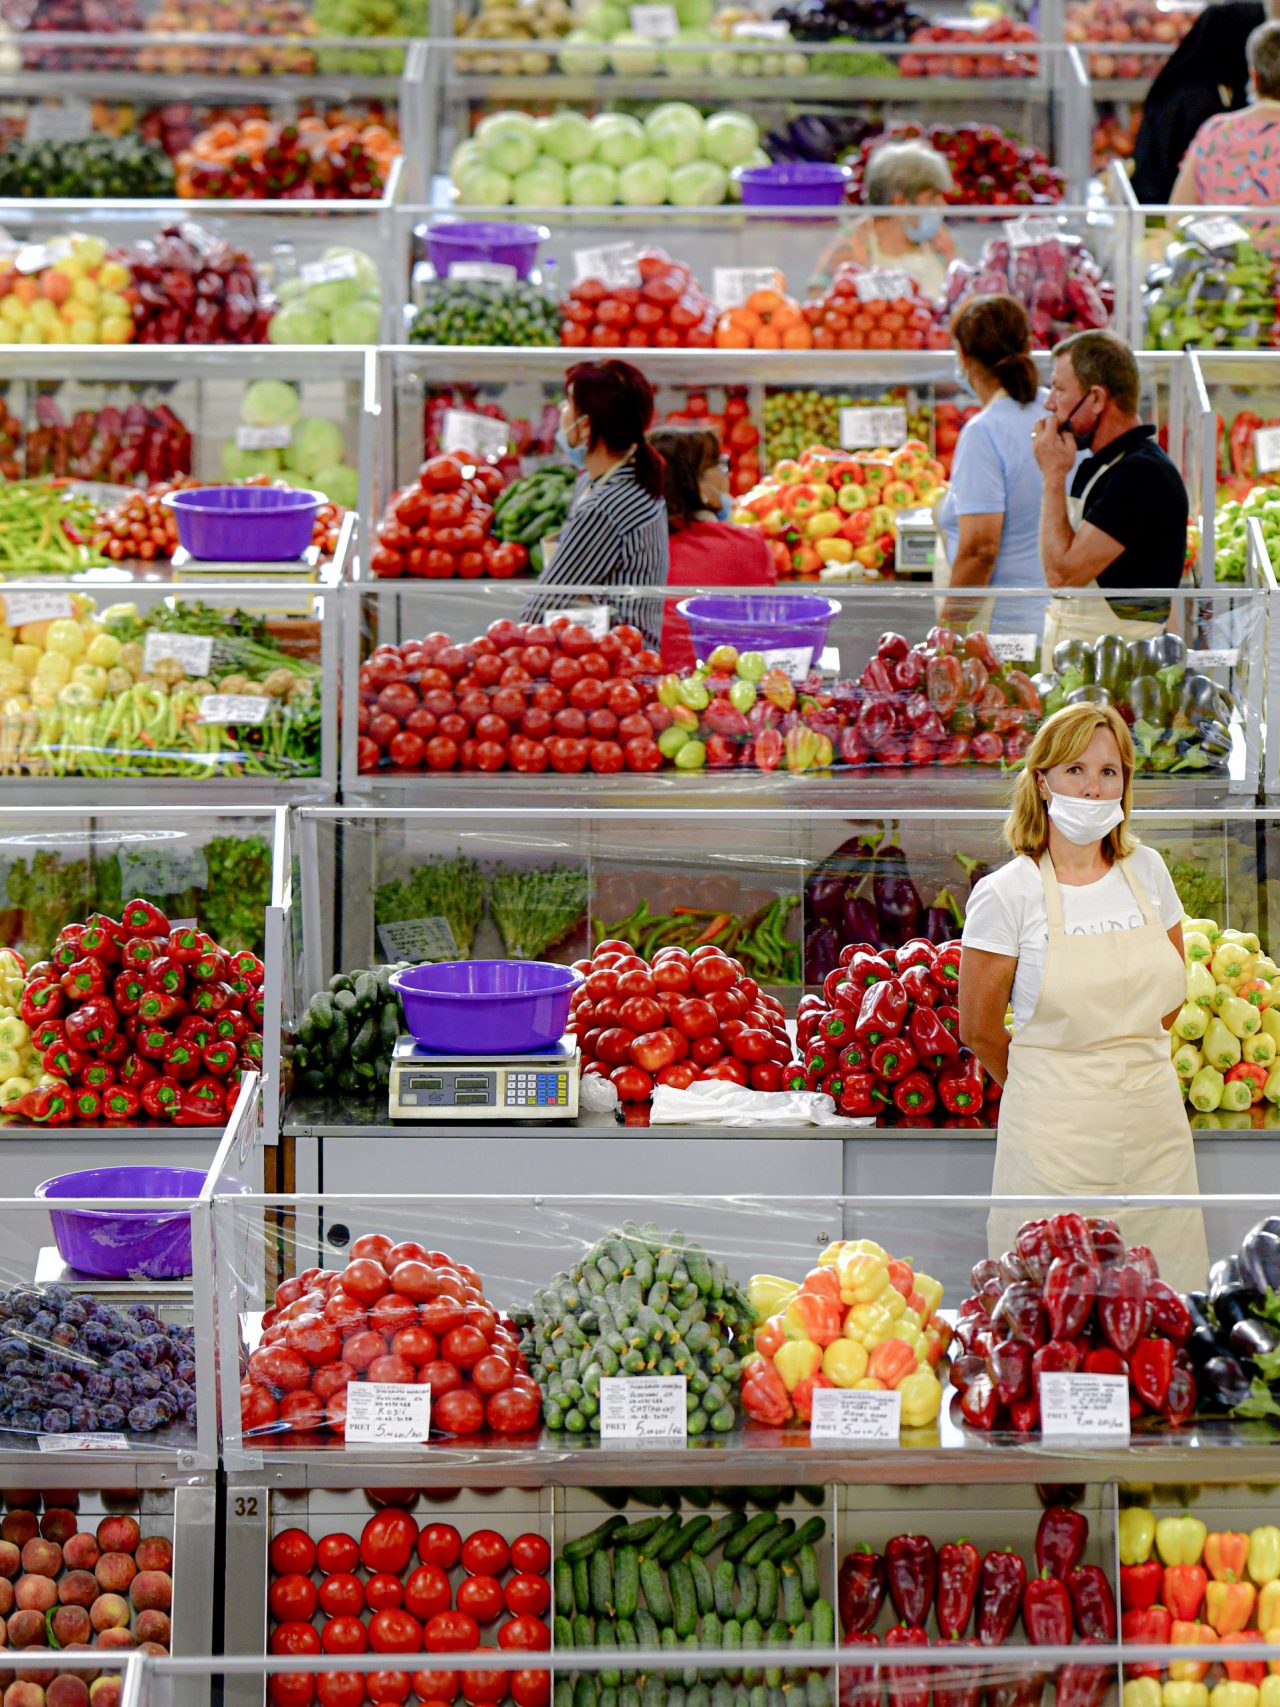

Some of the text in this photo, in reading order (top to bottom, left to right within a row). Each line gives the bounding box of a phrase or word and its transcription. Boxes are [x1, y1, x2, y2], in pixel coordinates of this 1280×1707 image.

[349, 1423, 371, 1432] PRET
[605, 1423, 627, 1431] PRET
[234, 1496, 258, 1516] 32
